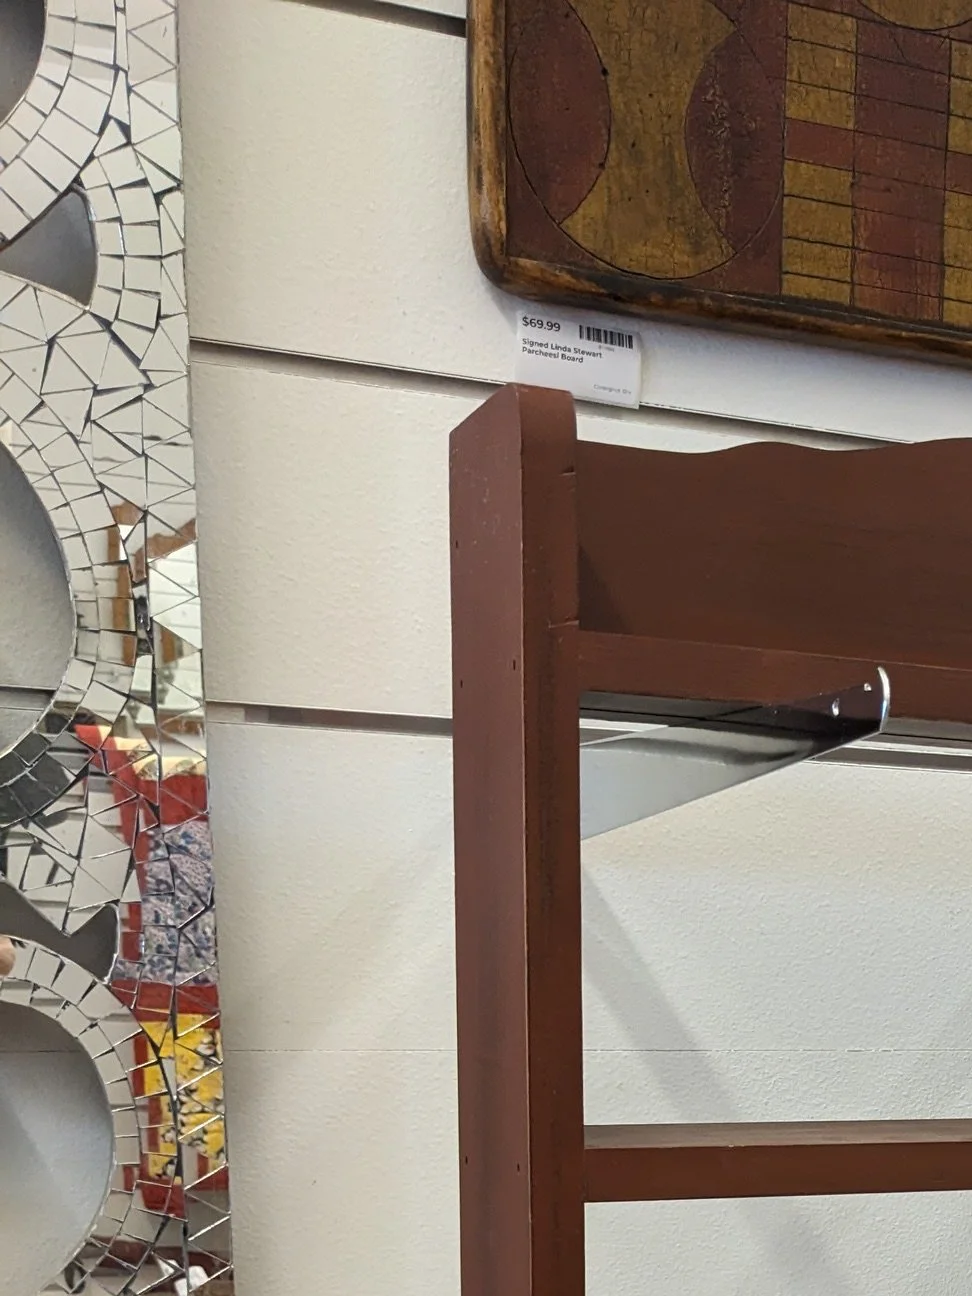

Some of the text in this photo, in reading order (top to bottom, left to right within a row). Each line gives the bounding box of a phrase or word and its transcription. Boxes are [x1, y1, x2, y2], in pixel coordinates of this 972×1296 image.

[522, 316, 561, 332] $69.99
[522, 337, 549, 349] Signed
[550, 343, 572, 354] Linda
[573, 347, 603, 359] Stewart
[522, 346, 584, 363] Parcheesi Board
